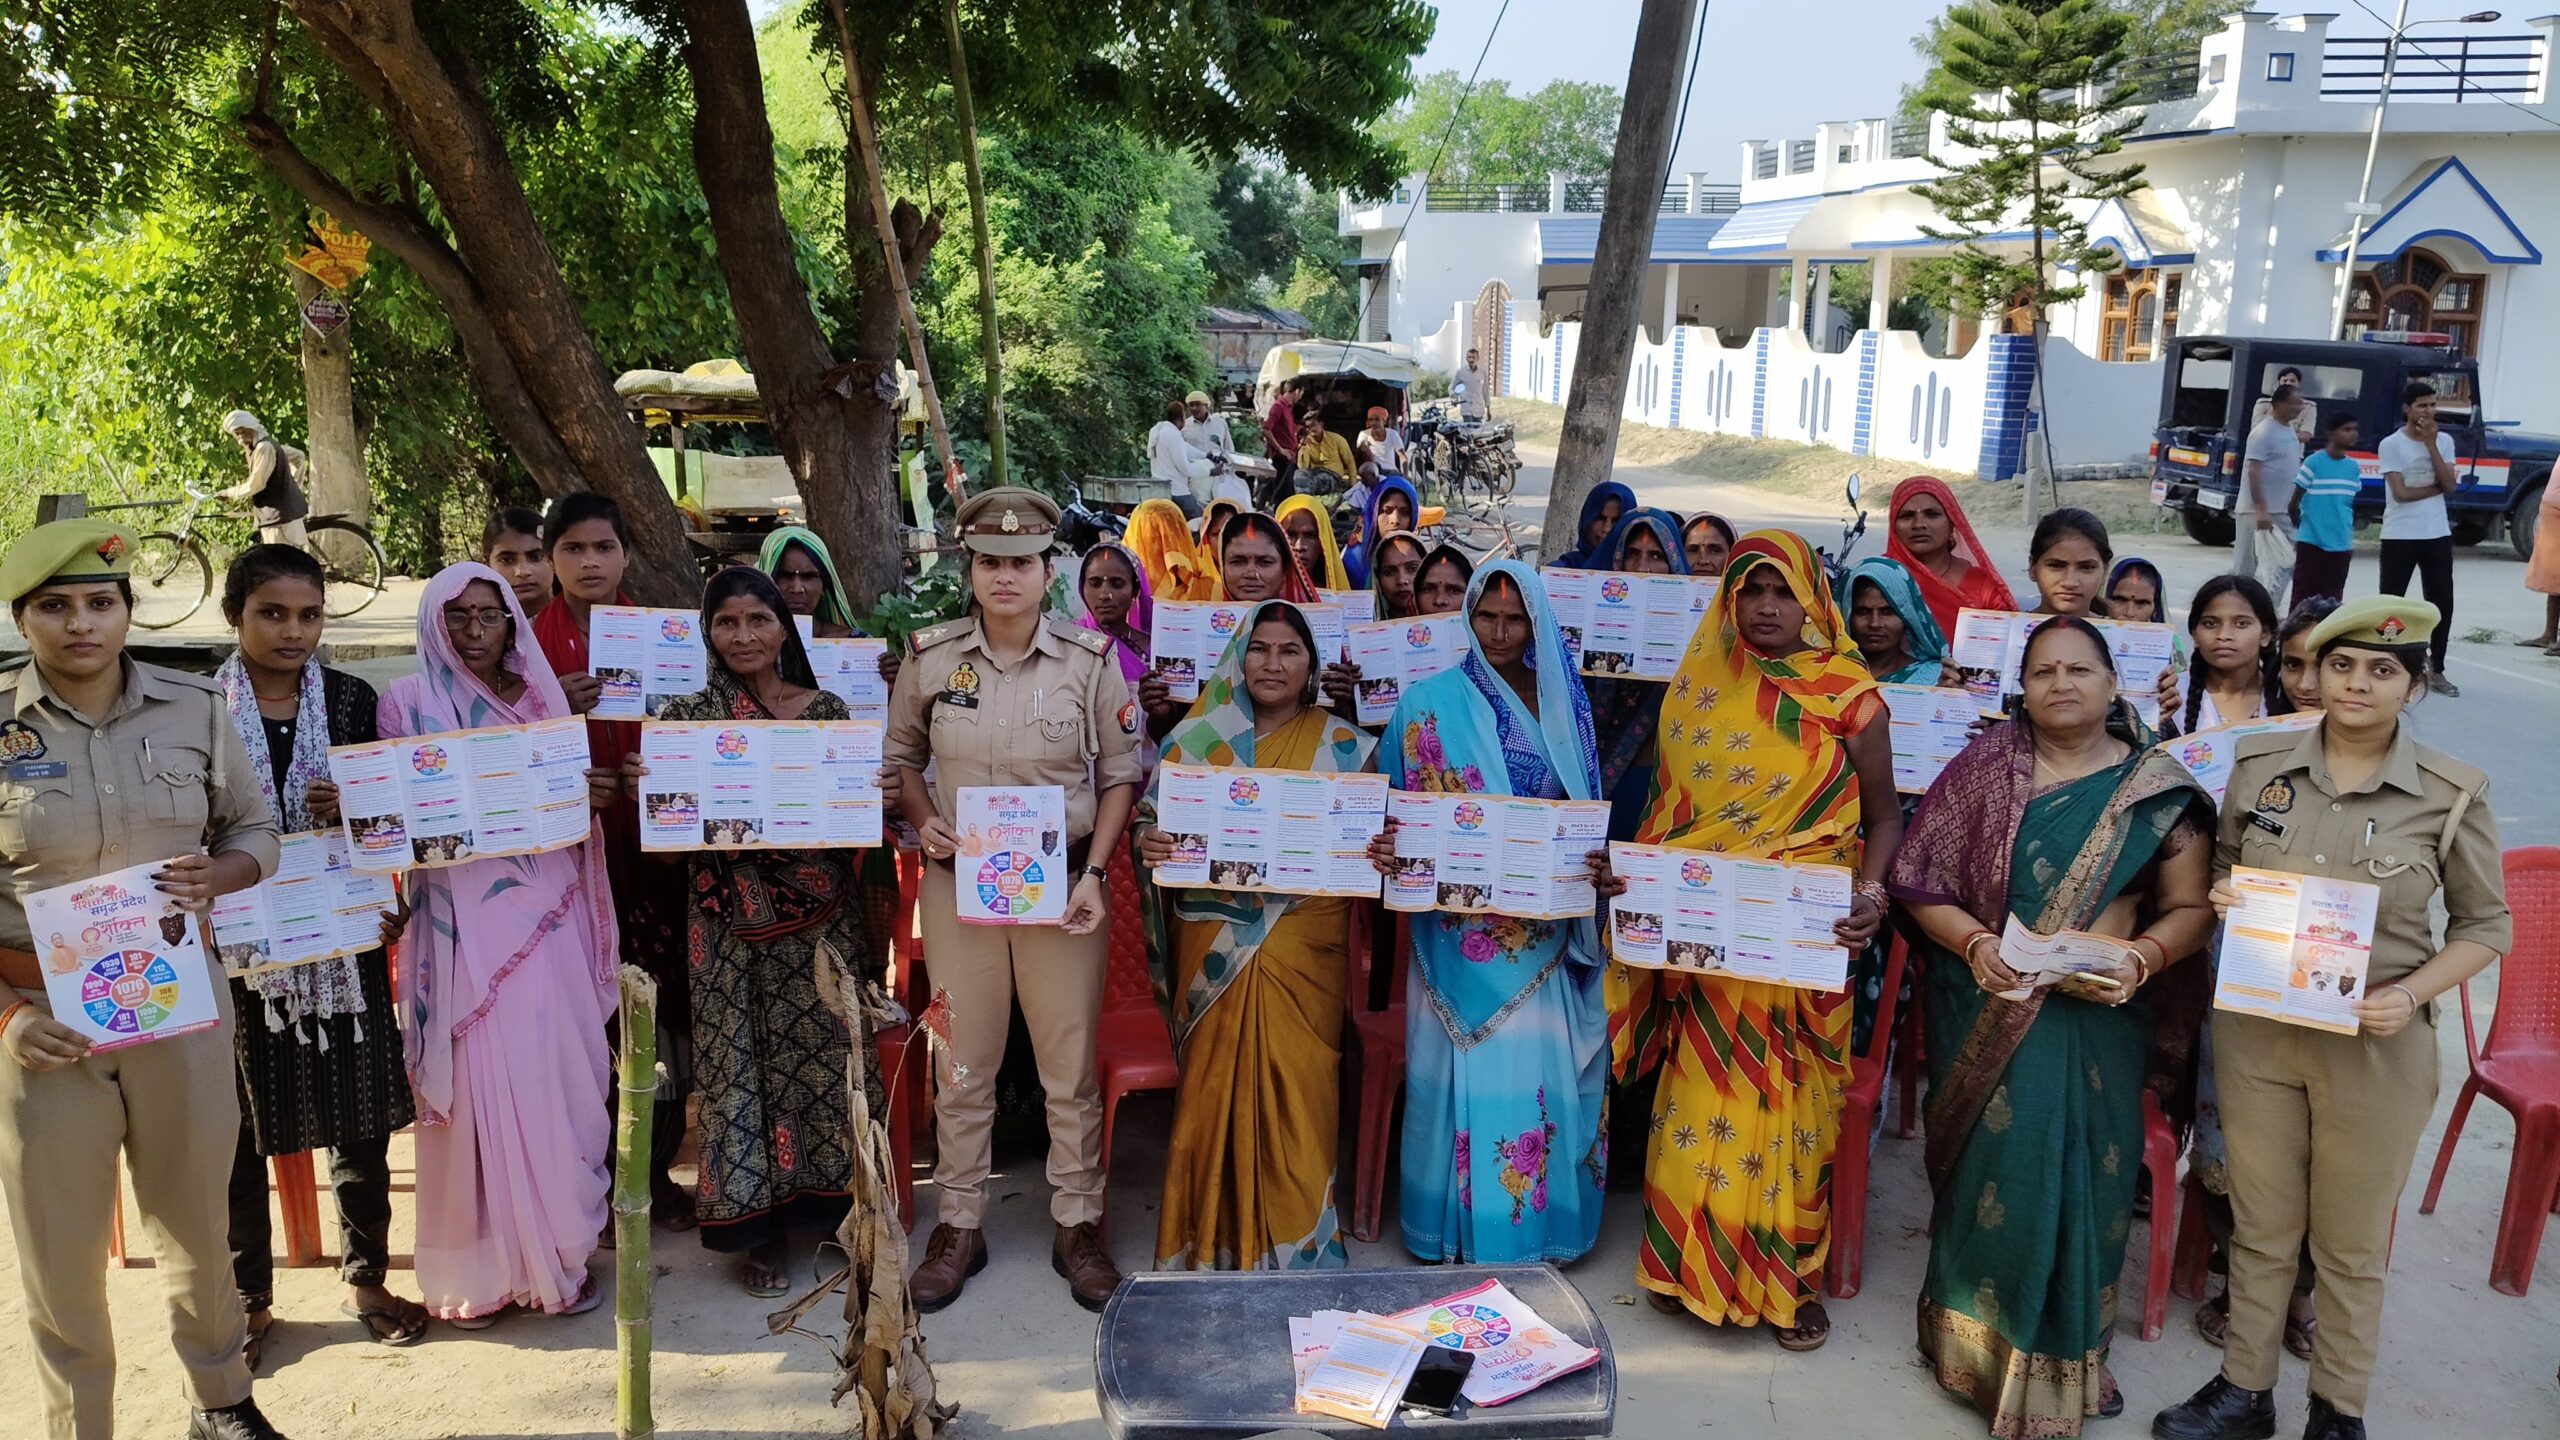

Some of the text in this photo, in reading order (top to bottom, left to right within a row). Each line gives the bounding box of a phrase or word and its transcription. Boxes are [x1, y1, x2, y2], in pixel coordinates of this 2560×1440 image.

[999, 808, 1038, 820] समृद्ध प्रदेश
[1001, 875, 1021, 885] 1076
[89, 895, 147, 917] समृद्ध प्रदेश
[101, 958, 120, 969] 1930
[154, 964, 166, 973] 112
[85, 980, 104, 990] 1090
[115, 979, 144, 995] 1076
[159, 987, 172, 995] 108
[1459, 1324, 1481, 1334] 1076
